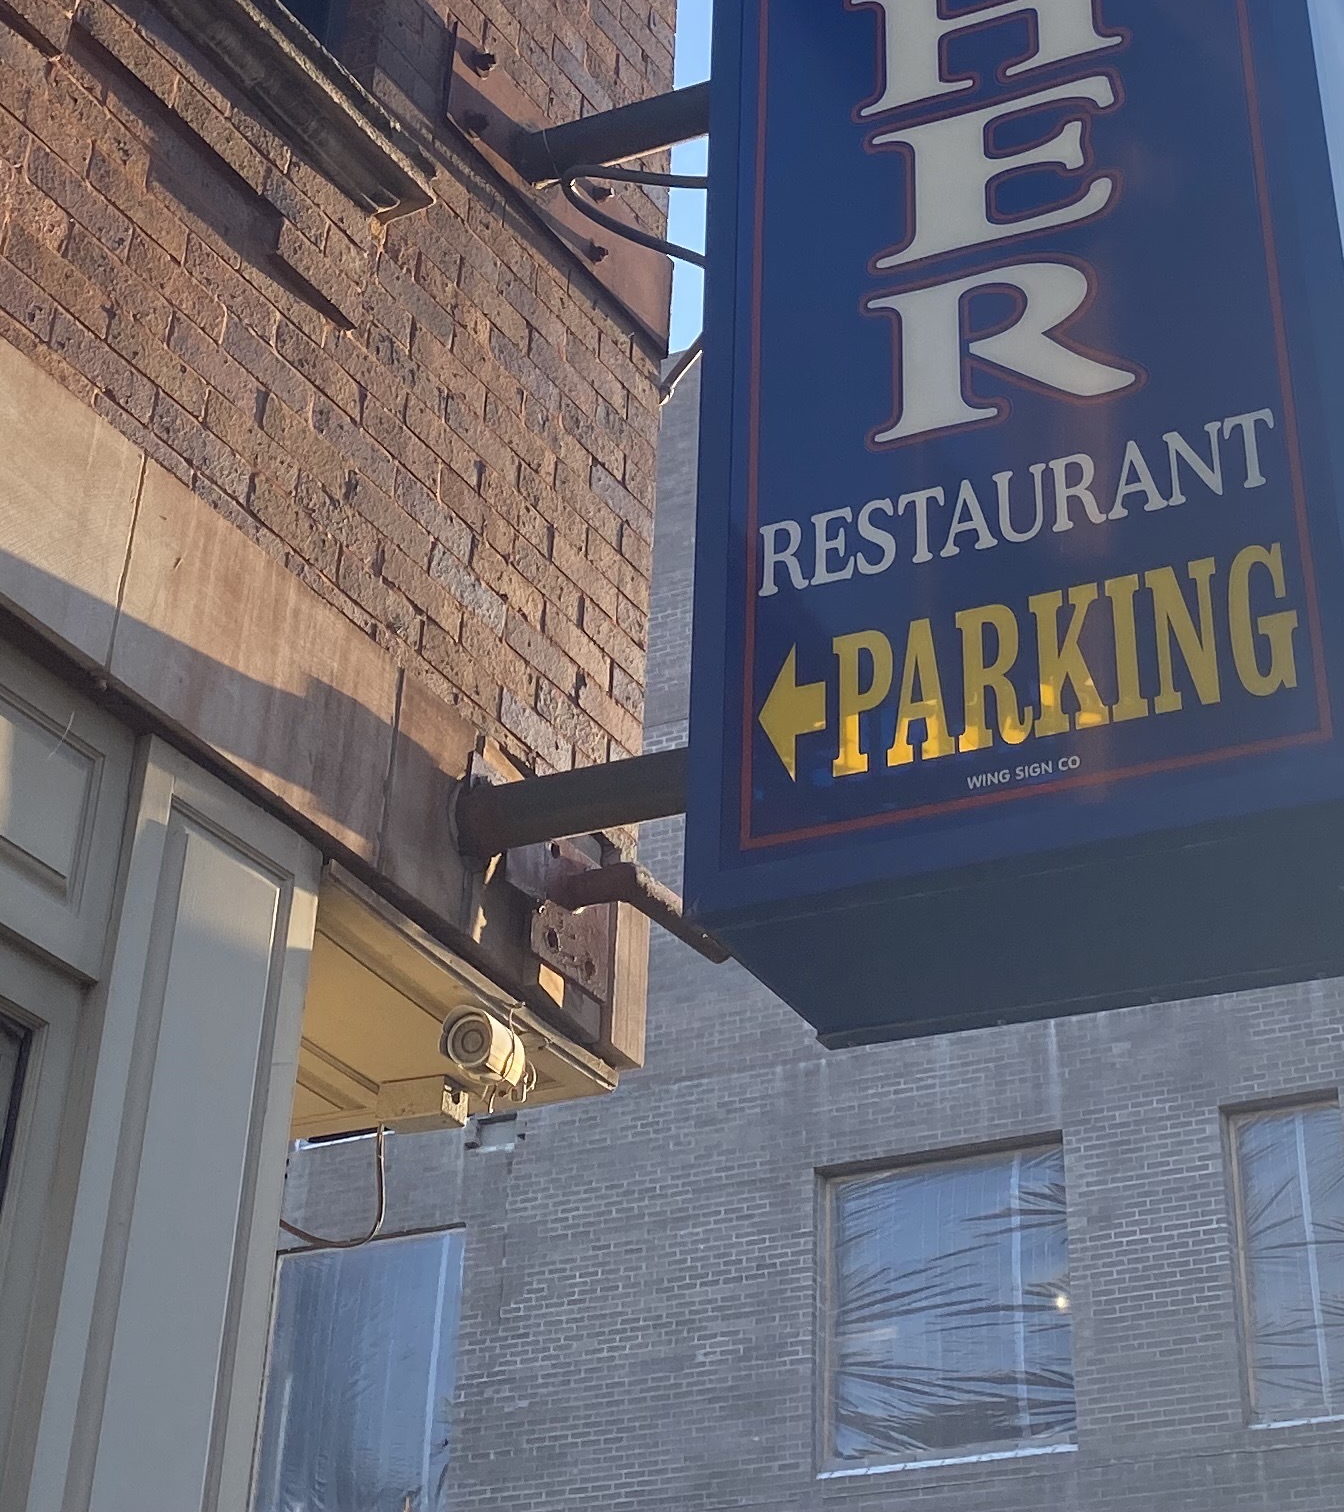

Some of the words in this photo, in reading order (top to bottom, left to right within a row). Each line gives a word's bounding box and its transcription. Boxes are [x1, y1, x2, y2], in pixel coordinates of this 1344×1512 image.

[758, 408, 1275, 597] RESTAURANT
[831, 541, 1299, 778] PARKING
[966, 769, 1011, 789] WING
[1015, 760, 1053, 779] SIGN
[1058, 755, 1081, 771] CO
